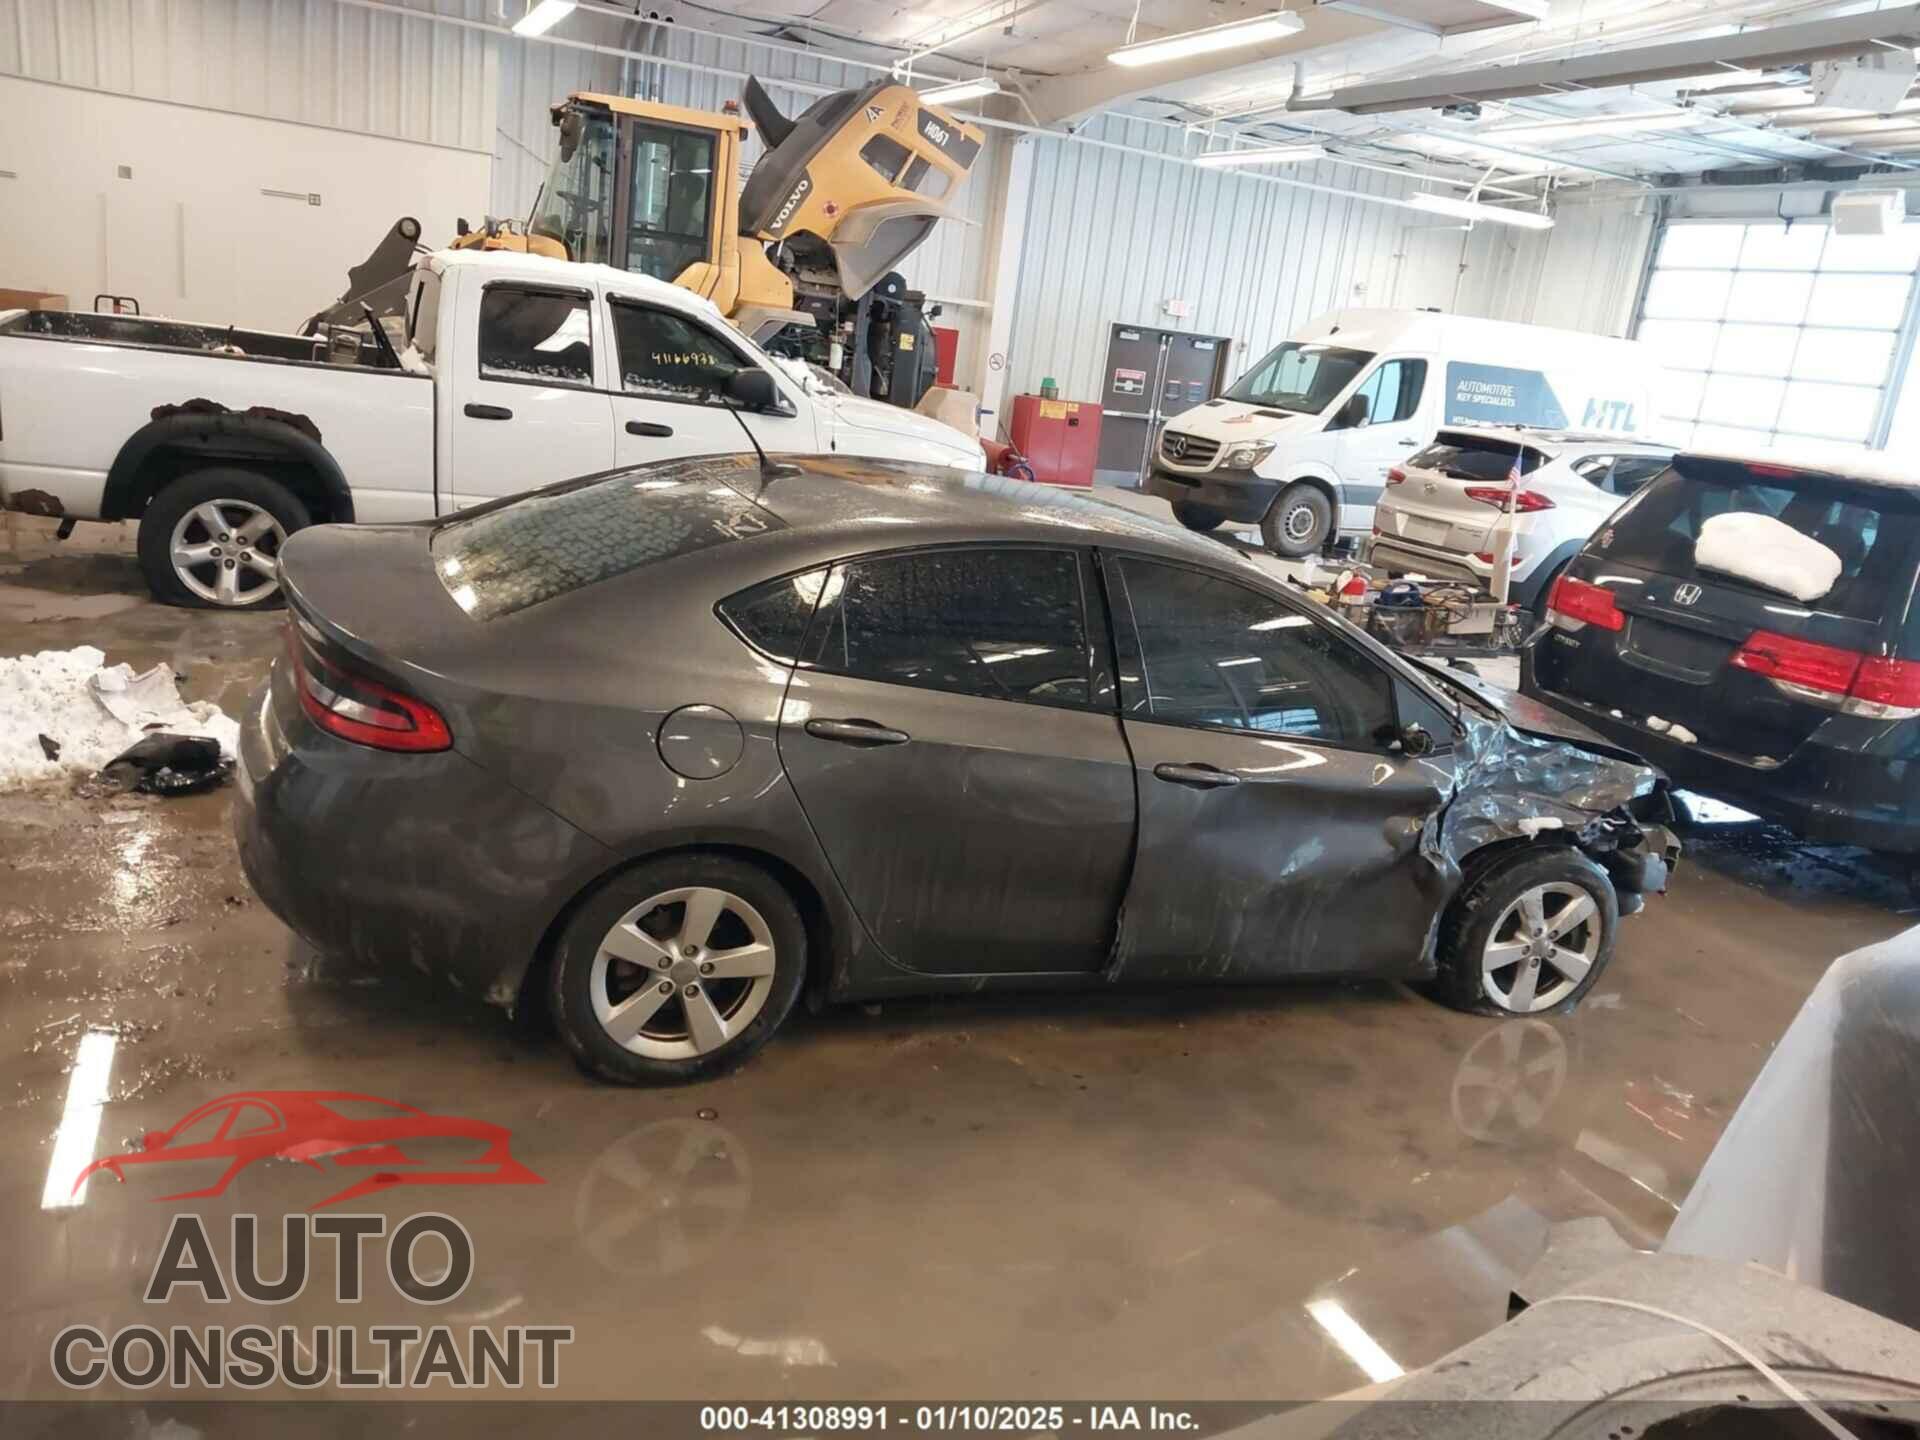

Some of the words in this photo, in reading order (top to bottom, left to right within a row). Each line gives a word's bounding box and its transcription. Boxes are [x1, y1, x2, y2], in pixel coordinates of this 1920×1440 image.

[770, 180, 809, 229] VOLVO
[1457, 380, 1515, 396] AUTOMOTIVE
[1456, 392, 1472, 402] KEY
[1472, 394, 1516, 407] SPECIALISTS
